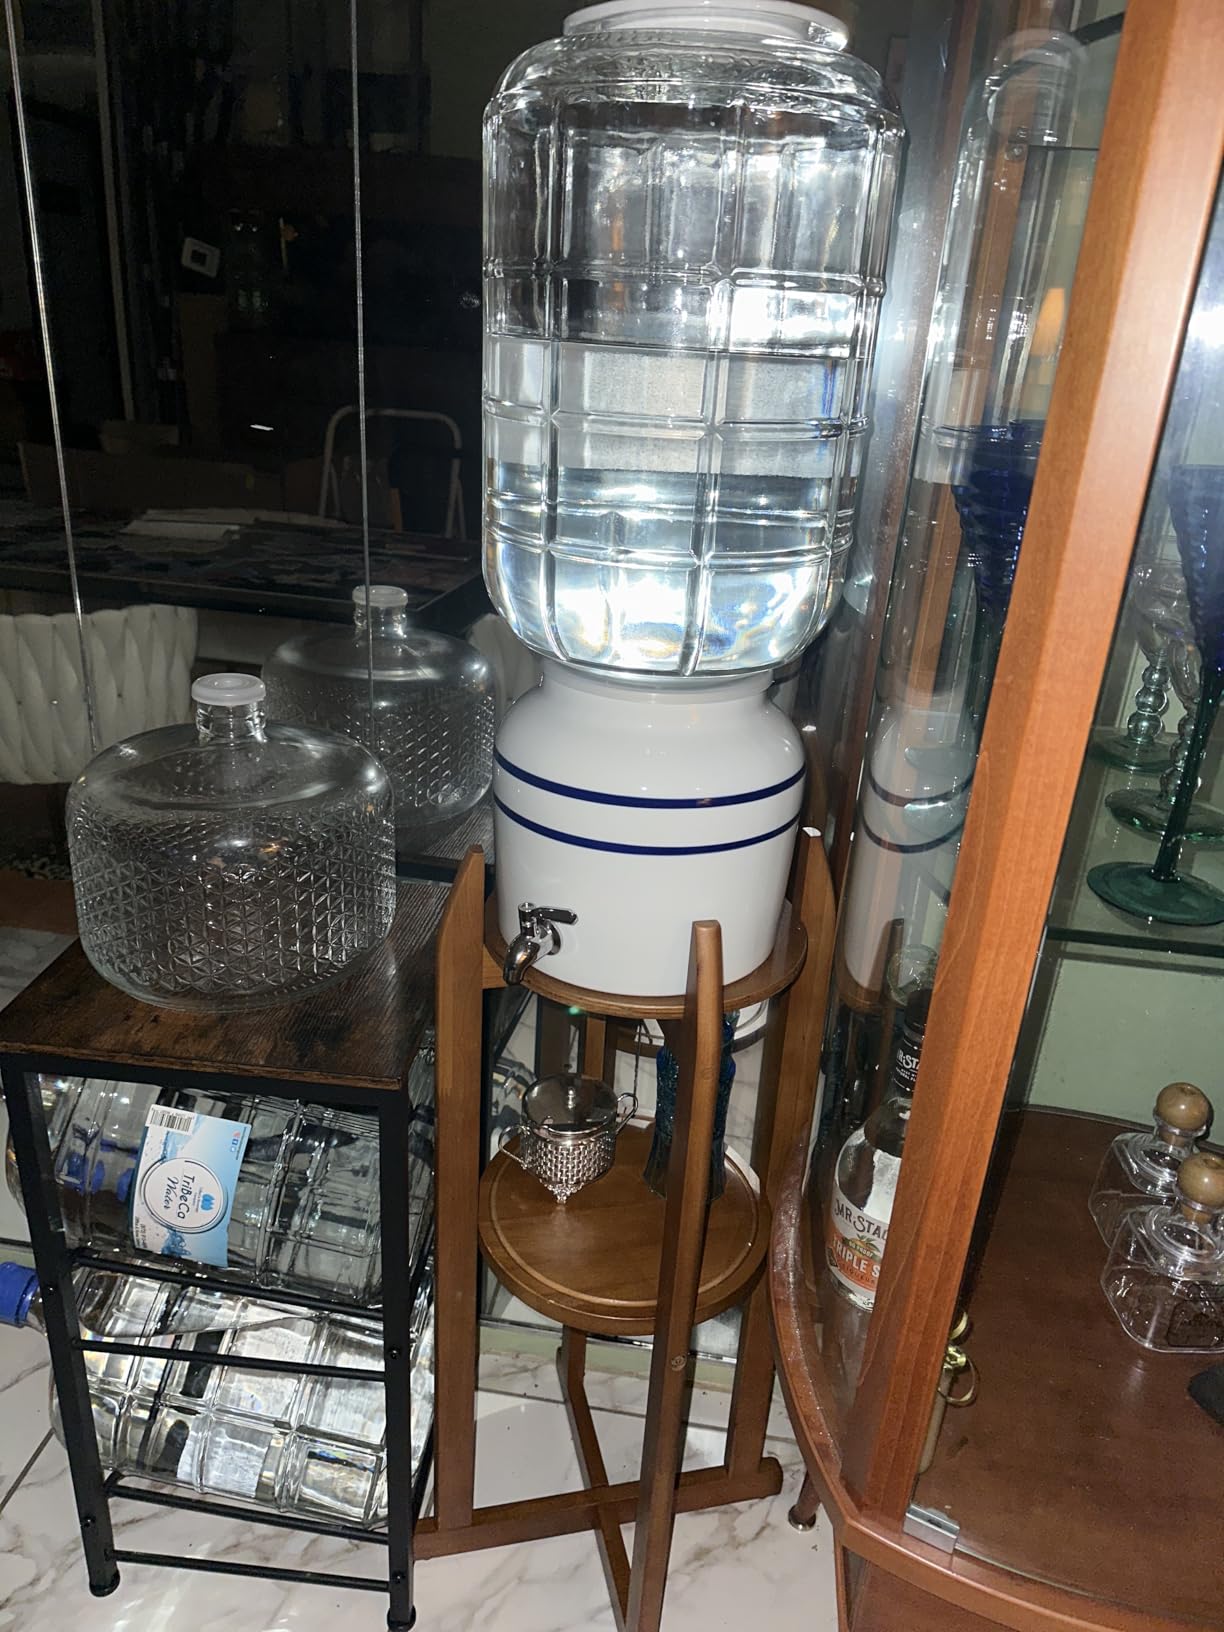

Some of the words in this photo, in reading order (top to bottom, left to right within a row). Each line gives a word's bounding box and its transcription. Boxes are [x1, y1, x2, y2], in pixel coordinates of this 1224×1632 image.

[164, 1176, 180, 1209] Water
[178, 1175, 195, 1220] TriBeCa
[833, 1233, 869, 1273] TRIPLE
